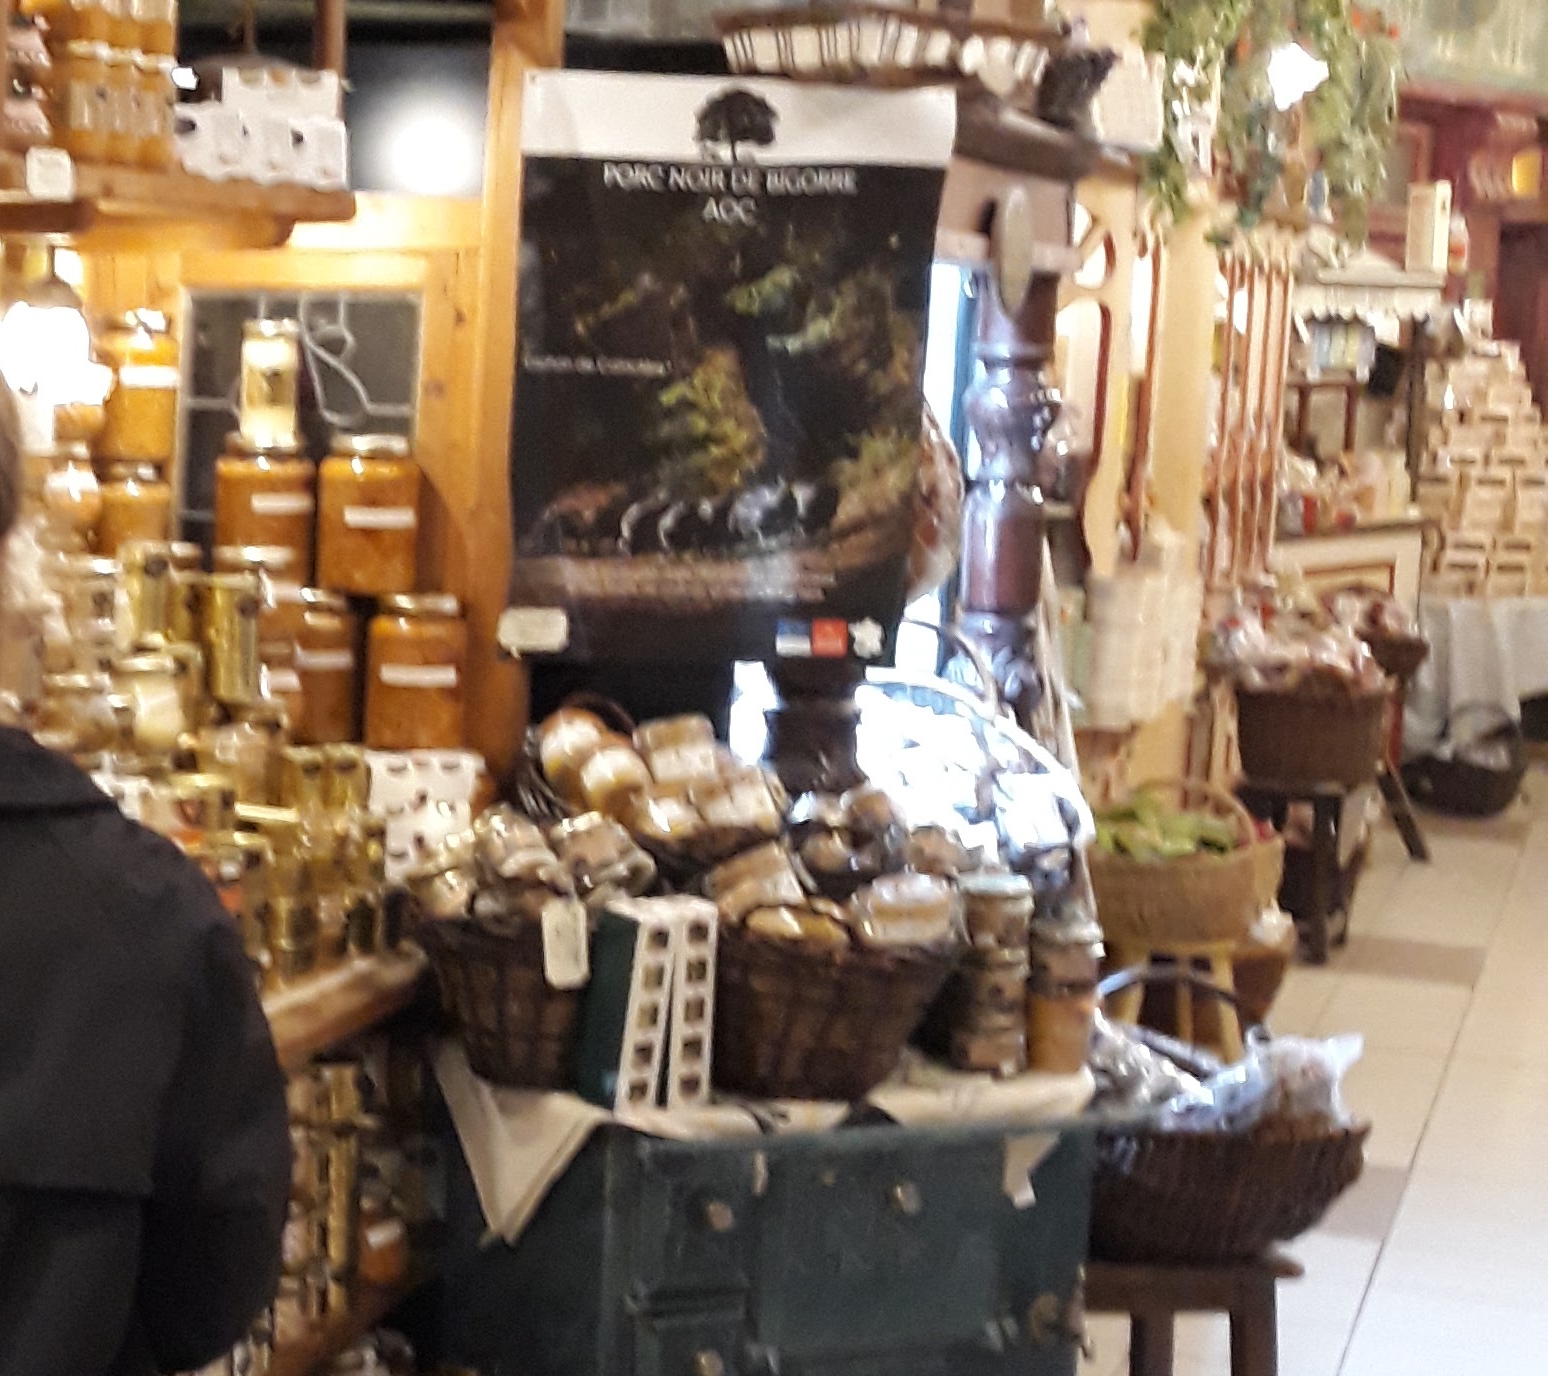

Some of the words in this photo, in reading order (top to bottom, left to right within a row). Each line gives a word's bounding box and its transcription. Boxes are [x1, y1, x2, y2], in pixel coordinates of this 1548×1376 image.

[602, 161, 665, 193] PORC
[667, 164, 727, 194] NOIR
[730, 166, 763, 197] DE
[765, 167, 858, 198] BIGORRE
